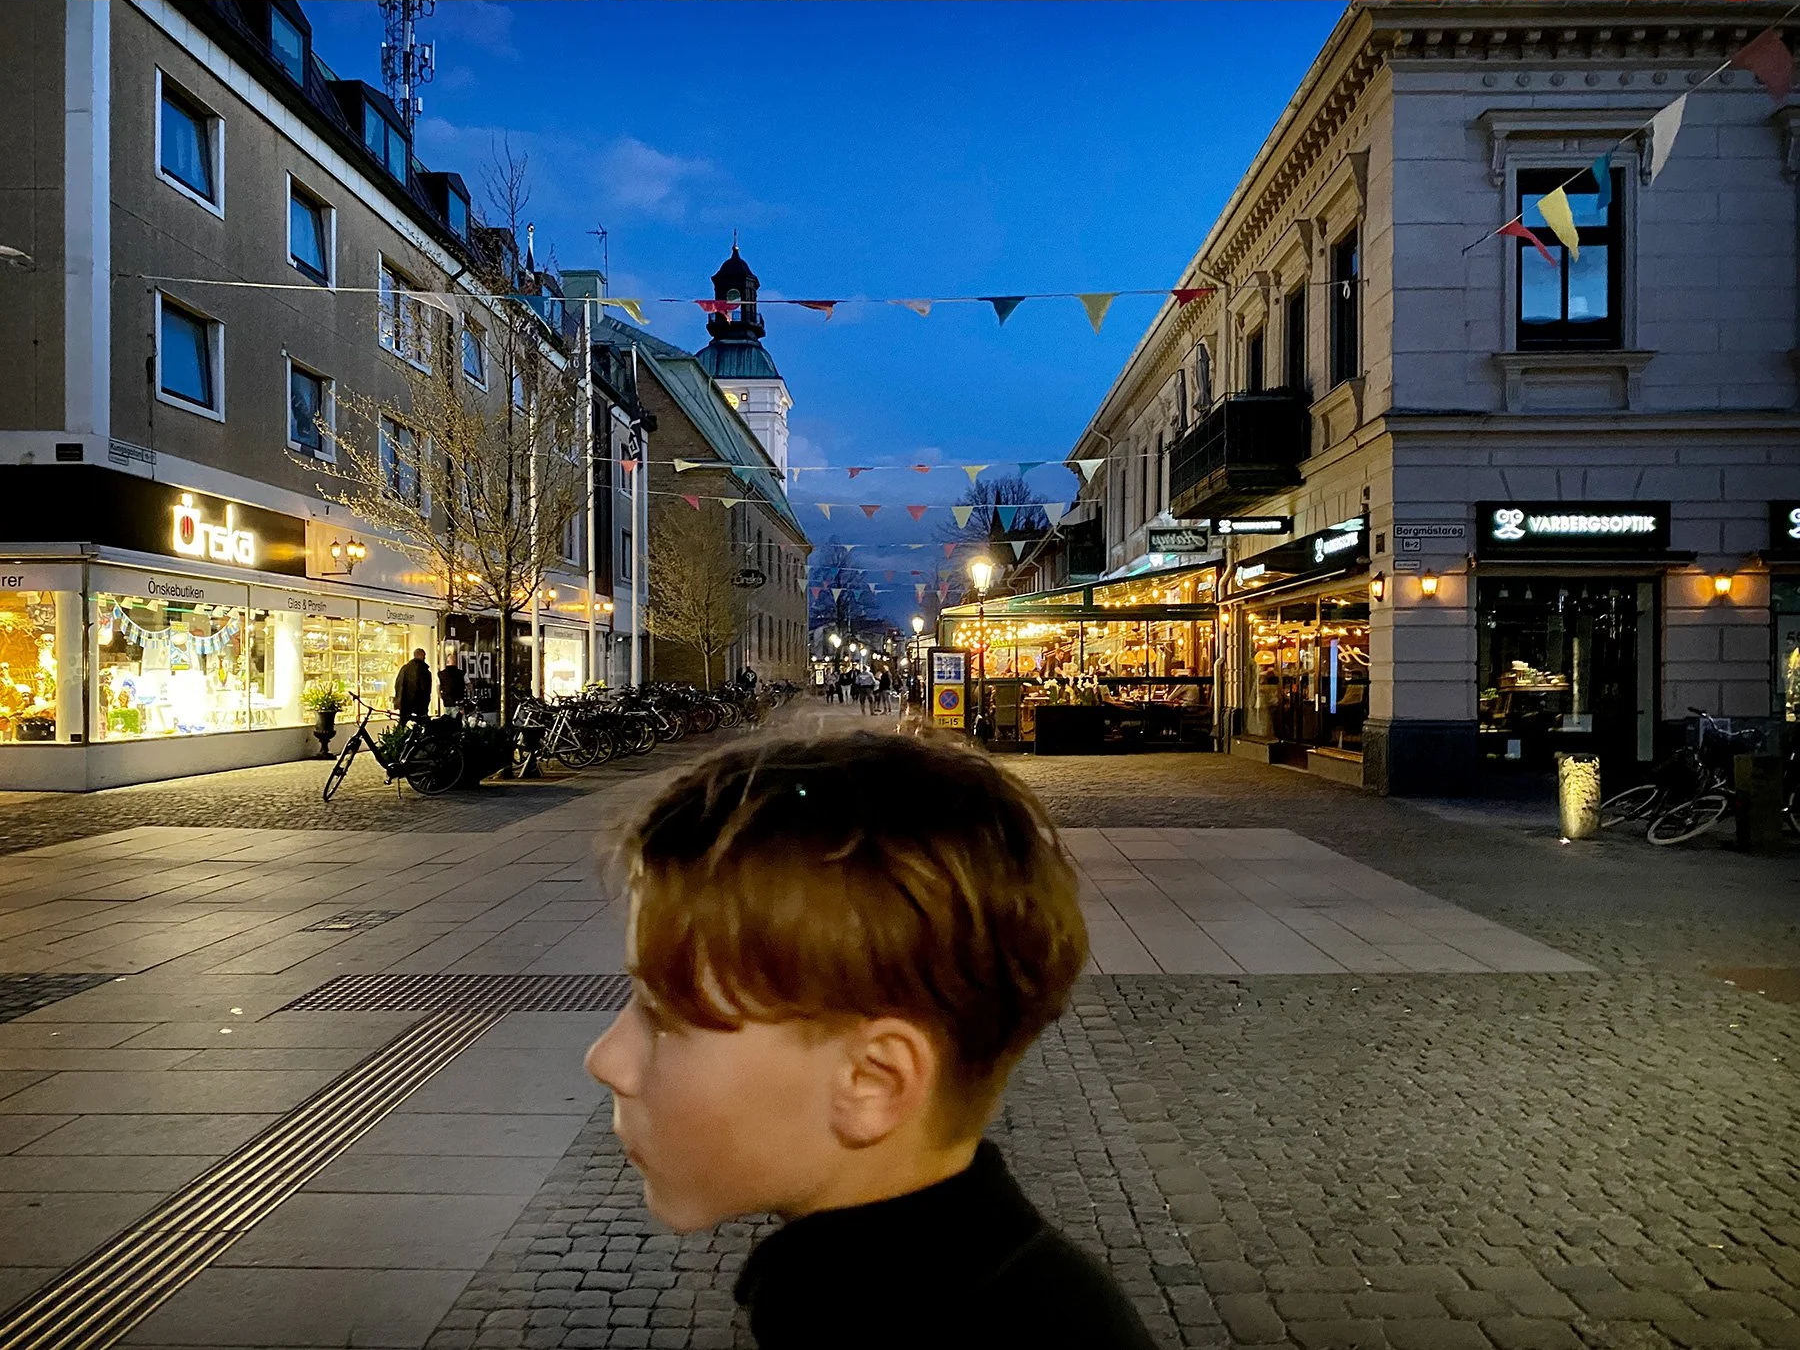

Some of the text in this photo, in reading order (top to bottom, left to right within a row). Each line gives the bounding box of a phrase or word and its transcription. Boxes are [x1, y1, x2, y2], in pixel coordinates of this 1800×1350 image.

[173, 493, 255, 565] Önska
[1528, 515, 1656, 533] VARBERGSOPTIK
[148, 577, 205, 599] Önskebutiken
[287, 597, 301, 609] Glas
[938, 718, 959, 726] 11-15
